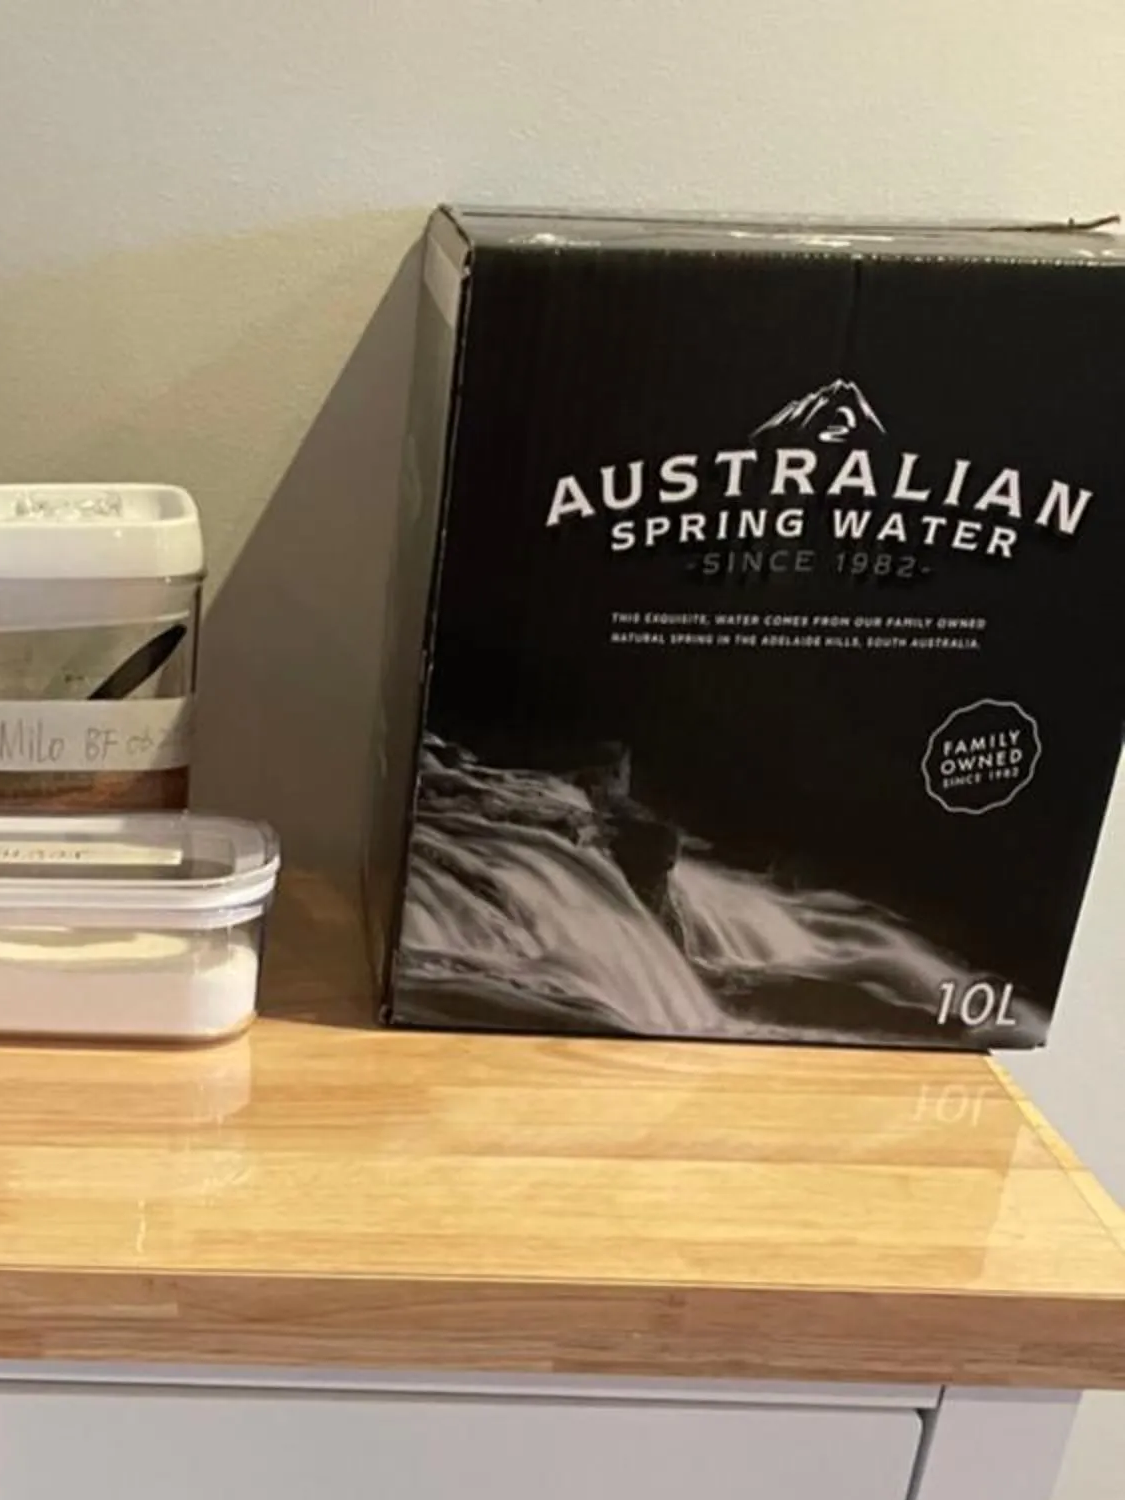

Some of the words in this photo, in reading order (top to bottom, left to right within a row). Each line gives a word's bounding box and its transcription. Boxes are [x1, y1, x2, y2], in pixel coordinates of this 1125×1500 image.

[545, 447, 1094, 535] AUSTRALIAN
[610, 507, 805, 551] SPRING
[832, 508, 1018, 559] WATER
[611, 611, 641, 625] THIS
[714, 613, 760, 627] WATER
[763, 614, 809, 628] COMES
[812, 615, 850, 628] FROM
[853, 616, 883, 629] OUR
[885, 616, 933, 629] FAMILY
[936, 616, 987, 630] OWNED
[610, 631, 666, 645] NATURAL
[670, 632, 714, 645] SPRING
[716, 633, 731, 646] IN
[734, 633, 758, 647] THE
[760, 634, 822, 648] ADELAIDE
[866, 636, 908, 649] SOUTH
[942, 728, 1021, 757] FAMILY
[939, 747, 1024, 776] OWNED
[936, 980, 1017, 1026] 10L
